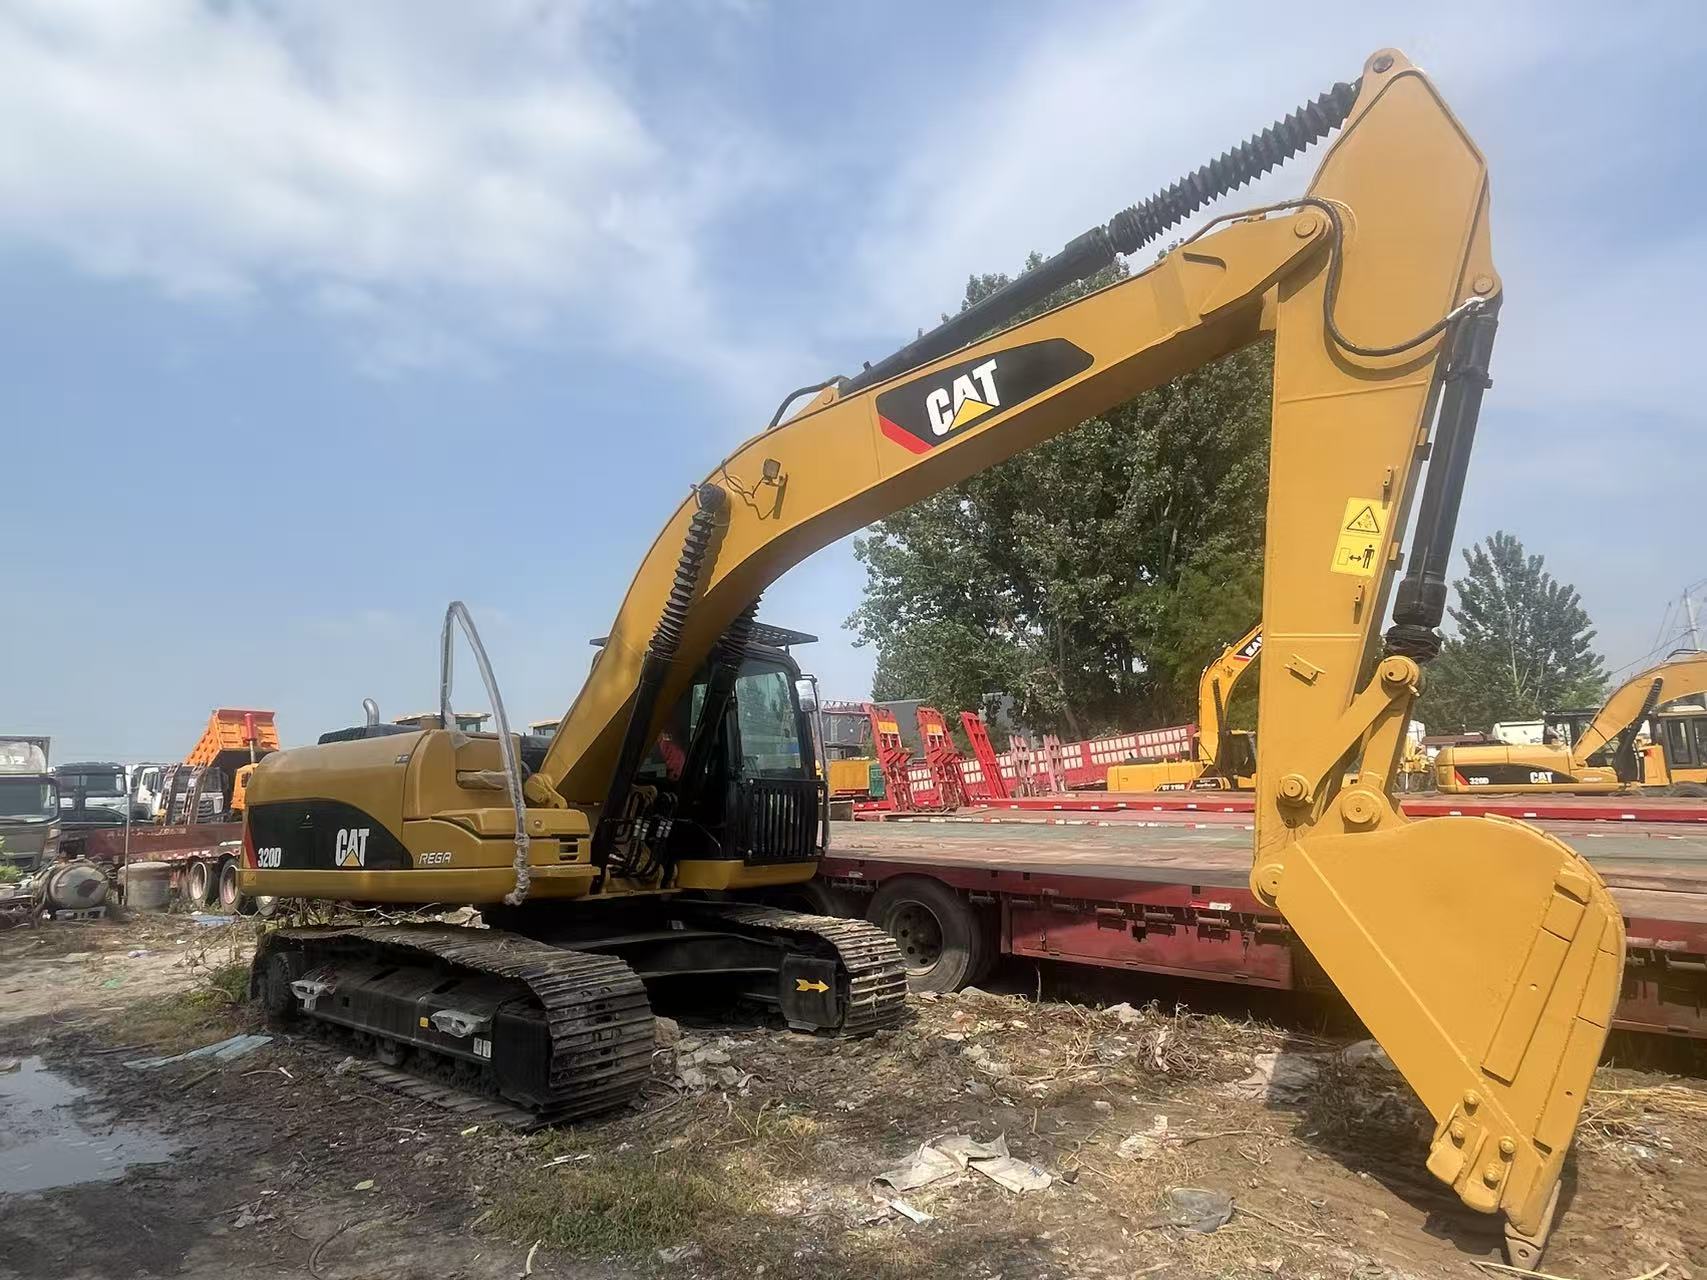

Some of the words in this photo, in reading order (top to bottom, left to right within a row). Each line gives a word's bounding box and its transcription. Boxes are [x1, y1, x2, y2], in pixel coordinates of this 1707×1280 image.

[925, 358, 1001, 437] CAT
[1529, 771, 1553, 784] CAT
[257, 847, 282, 868] 320D
[335, 828, 370, 867] CAT
[418, 851, 452, 865] REGA
